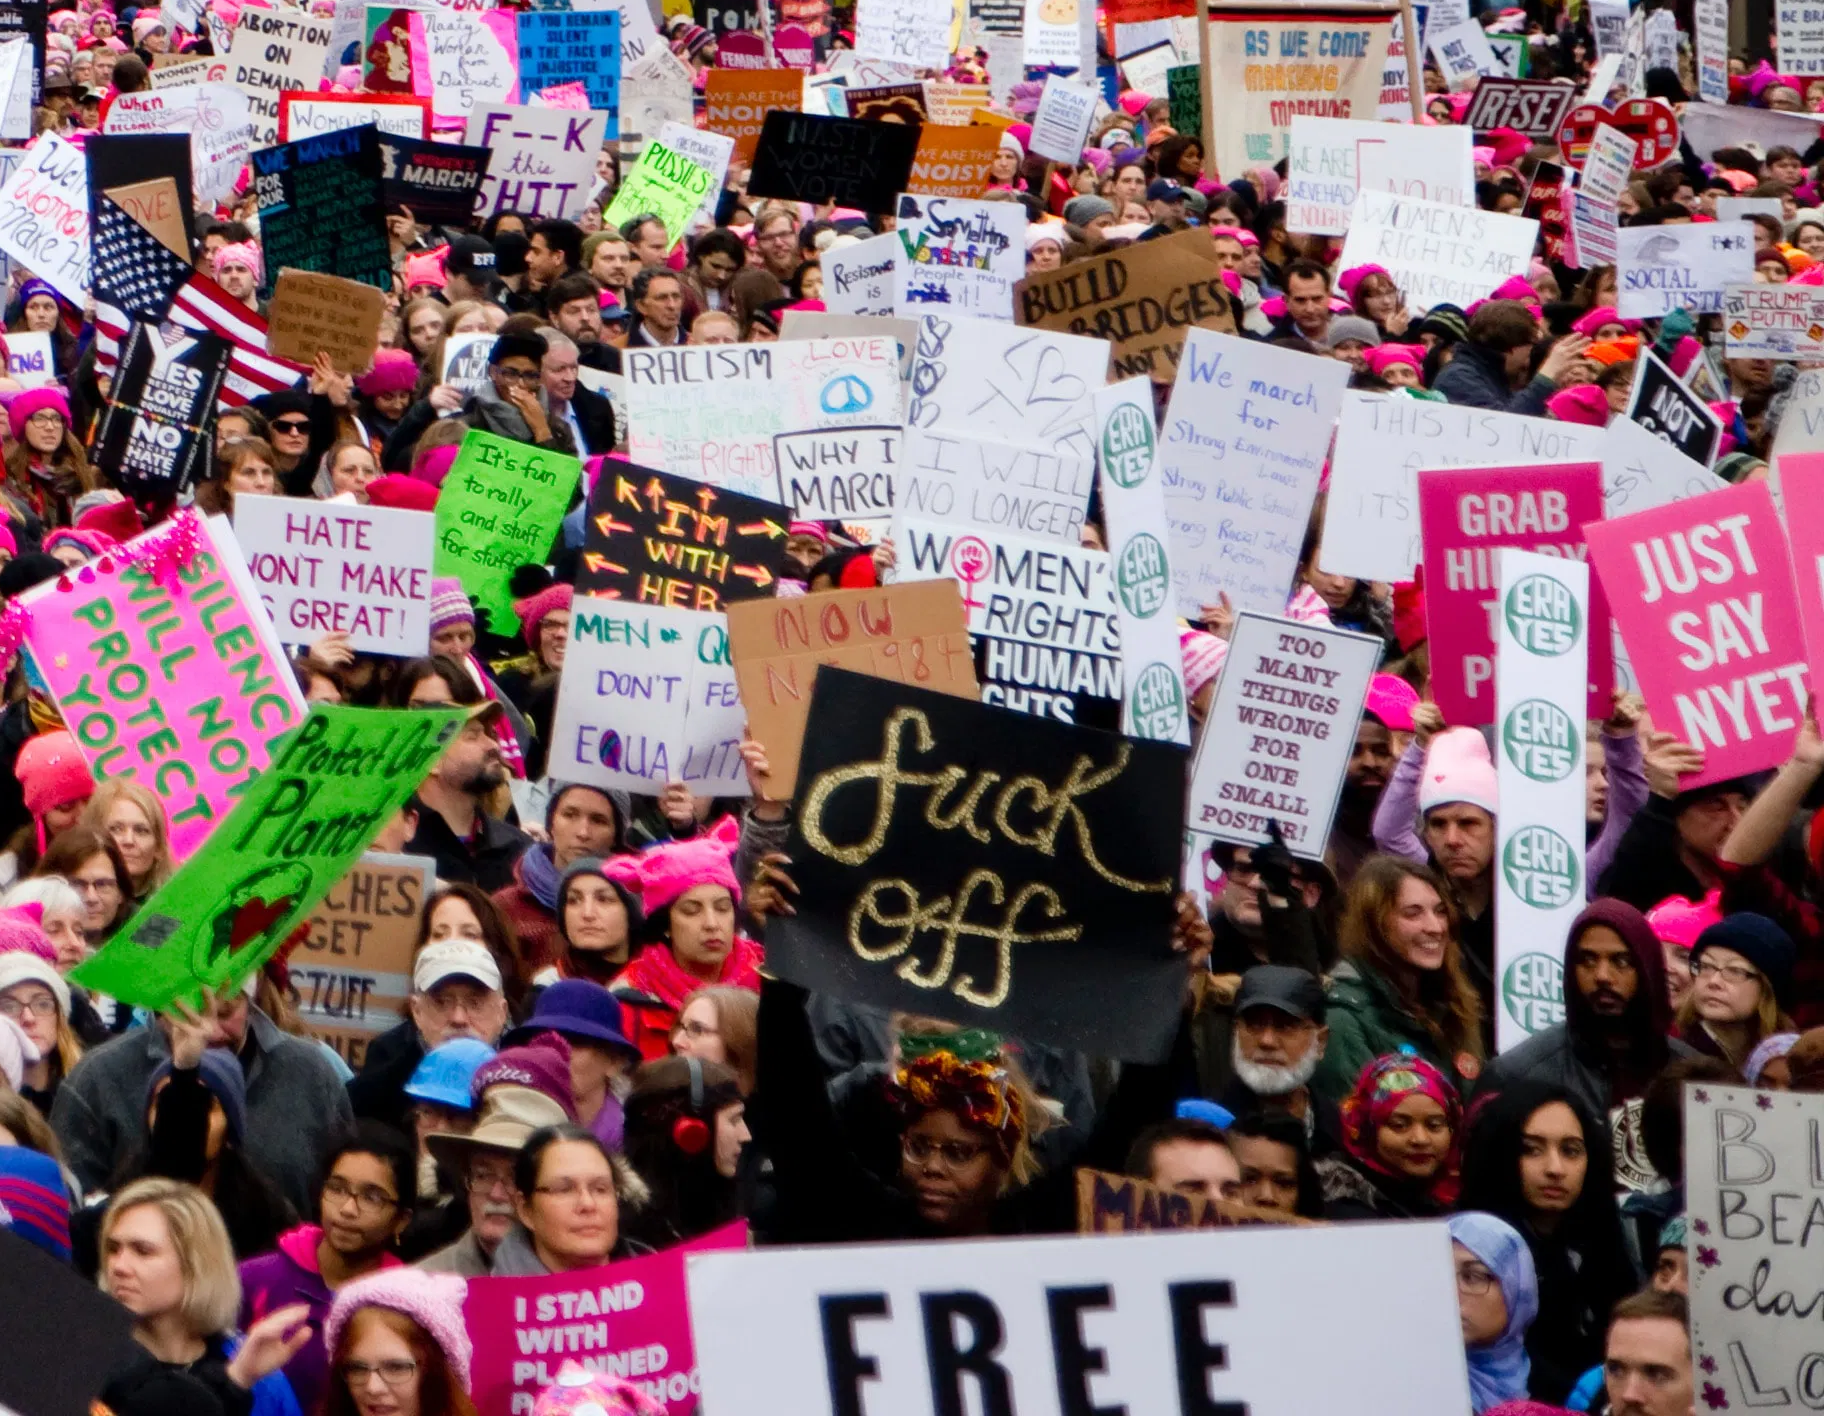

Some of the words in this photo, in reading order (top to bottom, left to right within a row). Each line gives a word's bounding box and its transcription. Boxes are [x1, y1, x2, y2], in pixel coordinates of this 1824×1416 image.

[237, 14, 331, 45] ABORTION
[264, 43, 292, 64] ON
[1460, 489, 1568, 537] GRAB
[286, 513, 371, 550] HATE
[1633, 515, 1758, 603] JUST
[342, 564, 428, 598] MAKE
[120, 567, 197, 681] WILL
[1669, 593, 1770, 671] SAY
[1279, 635, 1326, 659] TOO
[1256, 658, 1340, 687] MANY
[73, 598, 213, 825] PROTECT
[1243, 680, 1340, 715] THINGS
[1674, 663, 1808, 751] NYET
[1238, 709, 1331, 740] WRONG
[1252, 734, 1300, 761] FOR
[1246, 761, 1298, 786] ONE
[1219, 783, 1309, 816] SMALL
